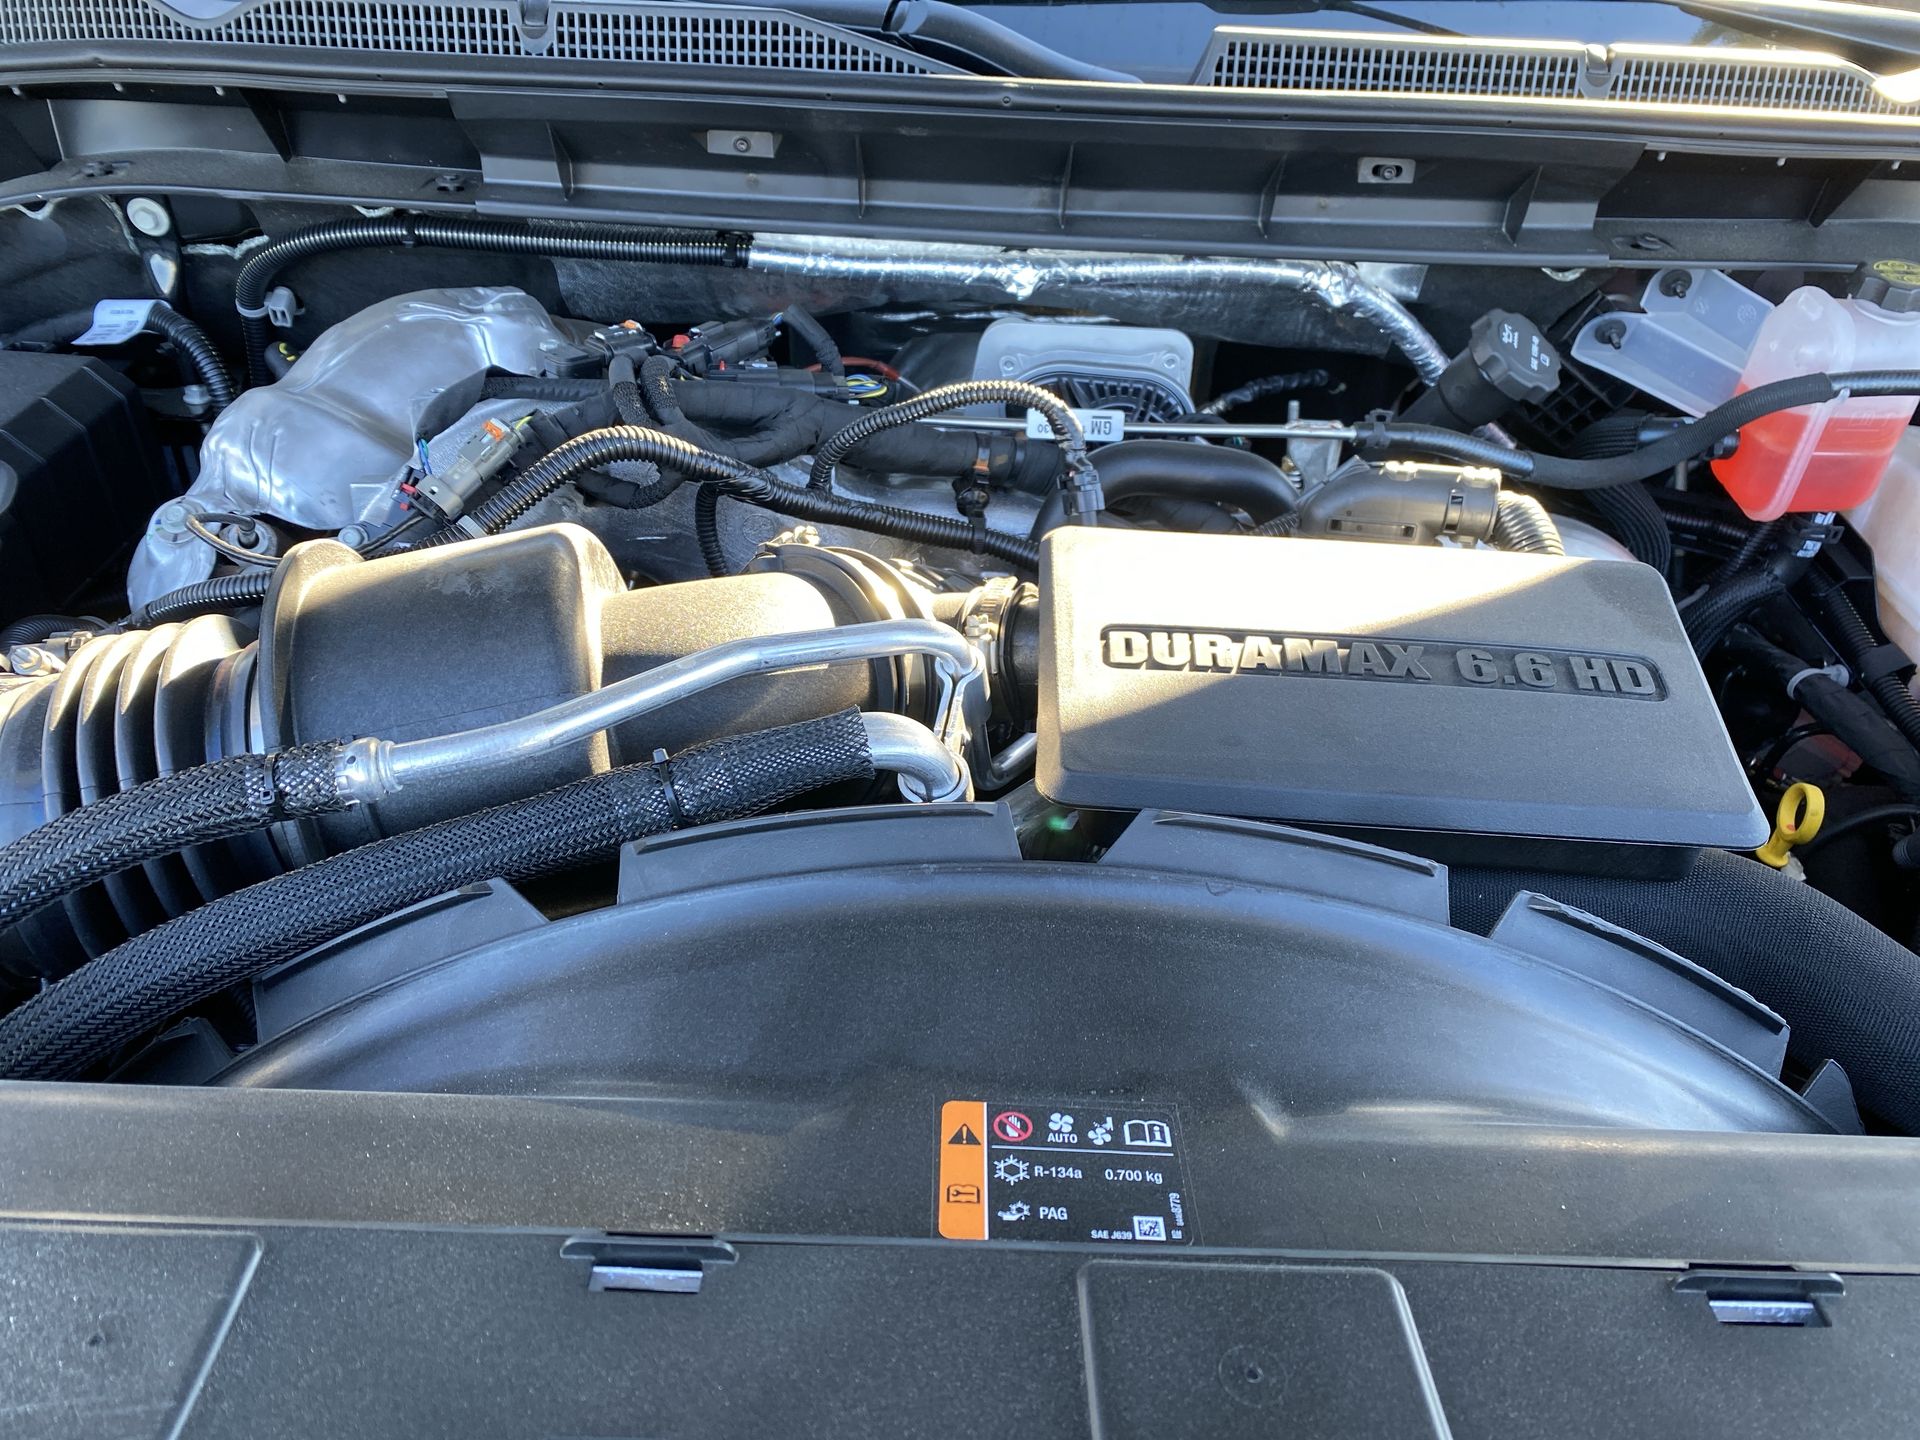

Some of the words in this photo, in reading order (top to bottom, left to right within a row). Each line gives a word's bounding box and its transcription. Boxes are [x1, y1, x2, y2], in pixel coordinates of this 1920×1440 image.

[1090, 420, 1112, 436] GM
[1106, 629, 1433, 681] DURAMAX
[1456, 648, 1559, 688] 6.6
[1568, 655, 1657, 697] HD
[1047, 1132, 1078, 1144] AUTO
[1034, 1165, 1083, 1180] R-134a
[1105, 1168, 1142, 1182] 0.700
[1145, 1169, 1163, 1185] kg
[1039, 1206, 1068, 1221] PAG
[1090, 1229, 1110, 1240] SAE
